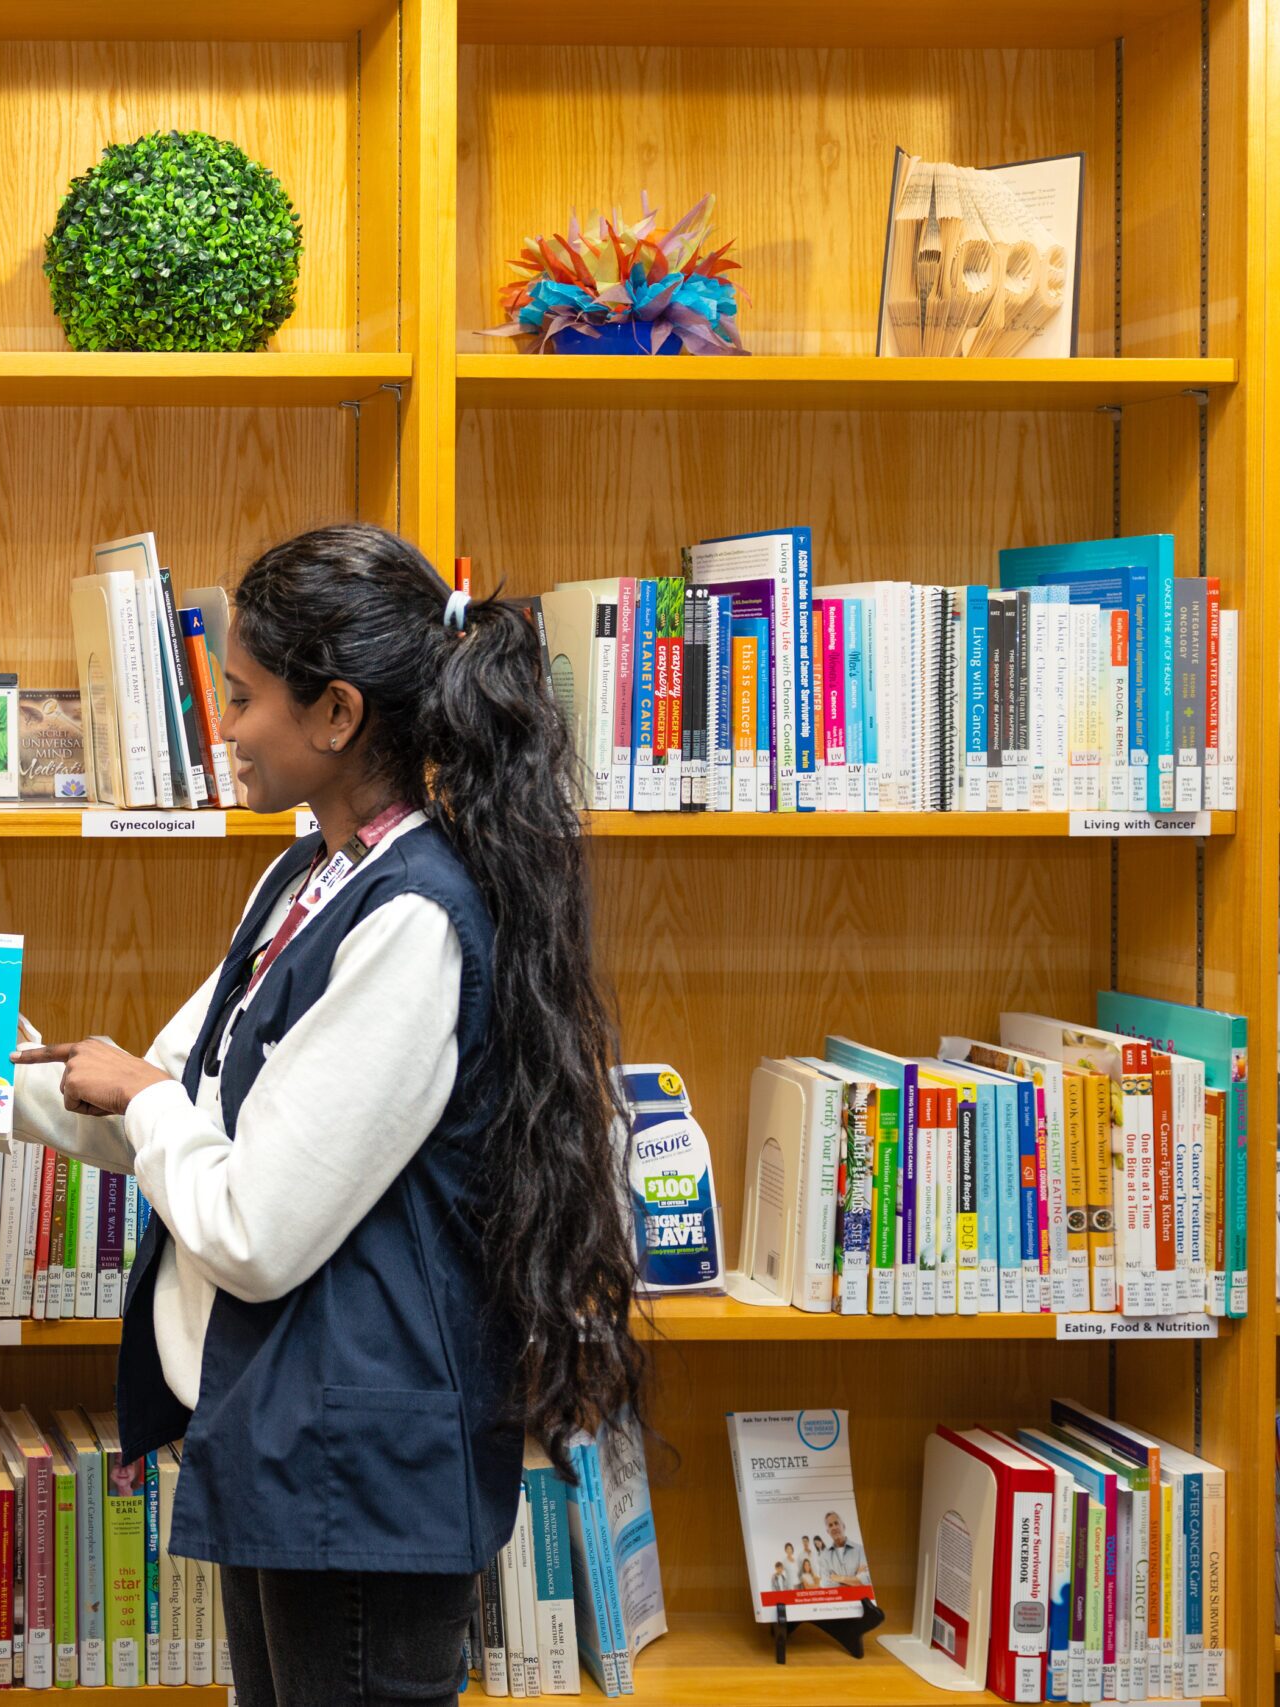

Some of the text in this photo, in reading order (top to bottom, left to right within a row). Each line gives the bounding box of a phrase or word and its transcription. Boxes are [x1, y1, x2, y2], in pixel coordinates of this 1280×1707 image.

[780, 543, 789, 574] Living
[780, 588, 790, 628] Healthy
[781, 632, 790, 652] Life
[798, 550, 811, 740] ACSM's Guide to Exercise and Cancer Survivorship
[621, 643, 629, 678] Mortals
[642, 631, 653, 691] PLANET
[782, 655, 791, 679] with
[741, 645, 753, 734] this is cancer
[782, 681, 791, 720] Chronic
[970, 627, 984, 750] Living with Cancer
[110, 820, 194, 831] Gynecological
[1084, 820, 1195, 831] Living with Cancer
[963, 1112, 971, 1138] Cancer
[637, 1135, 691, 1160] Ensure
[821, 1089, 838, 1197] Fortify Your LIFE
[1159, 1124, 1169, 1241] Cancer-Fighting Kitchen
[645, 1214, 703, 1227] SIGN UP
[645, 1228, 706, 1248] SAVE
[1065, 1322, 1209, 1334] Eating, Food & Nutrition
[751, 1456, 808, 1469] PROSTATE
[1020, 1517, 1029, 1583] SOURCEBOOK
[1032, 1502, 1044, 1599] Cancer Survivorship
[114, 1578, 141, 1589] star
[119, 1568, 136, 1576] this
[121, 1607, 134, 1615] go
